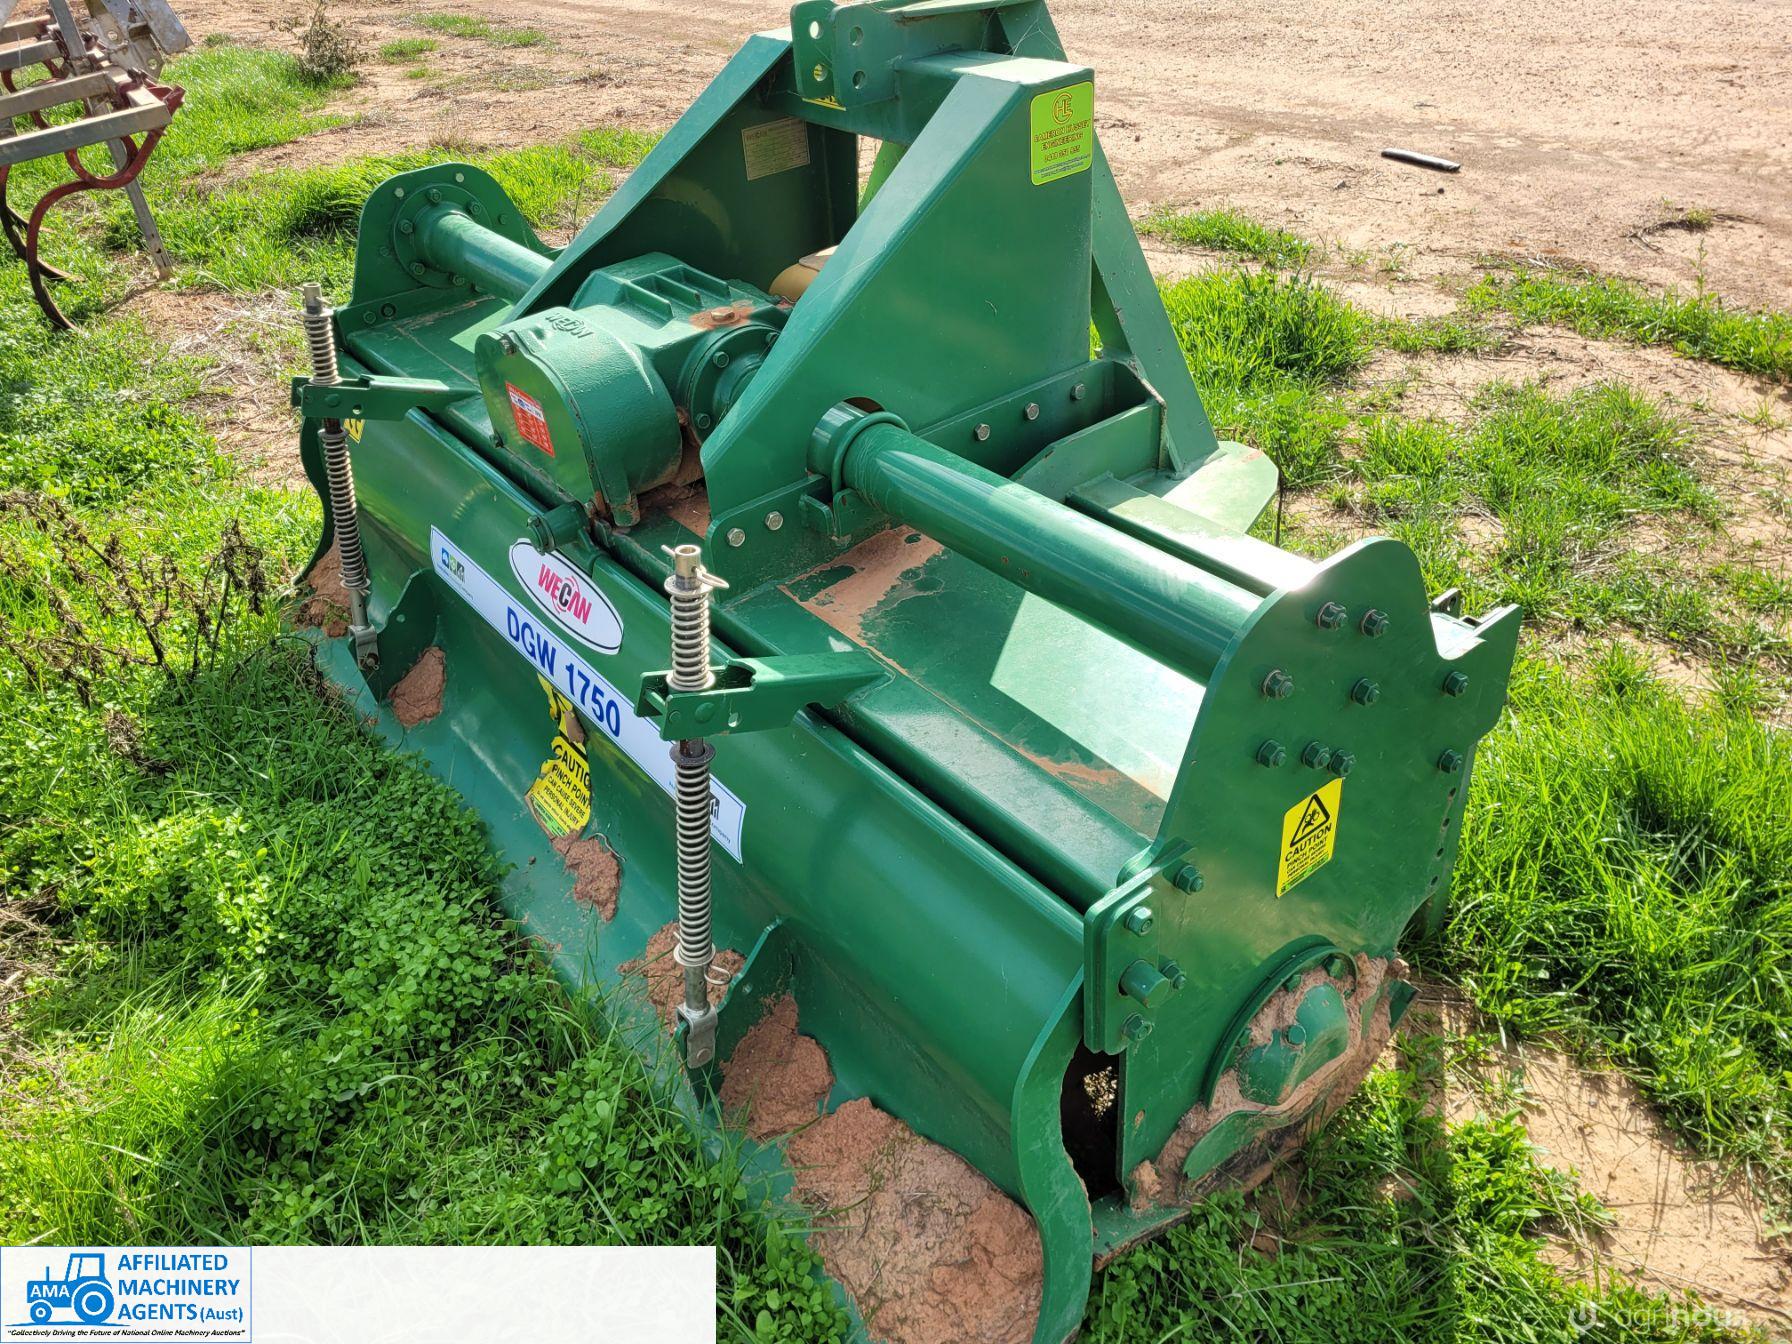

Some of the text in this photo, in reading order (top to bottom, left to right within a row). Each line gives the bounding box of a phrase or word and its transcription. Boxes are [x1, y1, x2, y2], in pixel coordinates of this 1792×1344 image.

[537, 563, 593, 625] WECAN
[507, 606, 621, 738] DGW 1750
[552, 764, 572, 789] PINCH
[553, 744, 591, 789] CAUTIO
[1285, 822, 1332, 862] CAUTION
[1309, 835, 1328, 854] POINT
